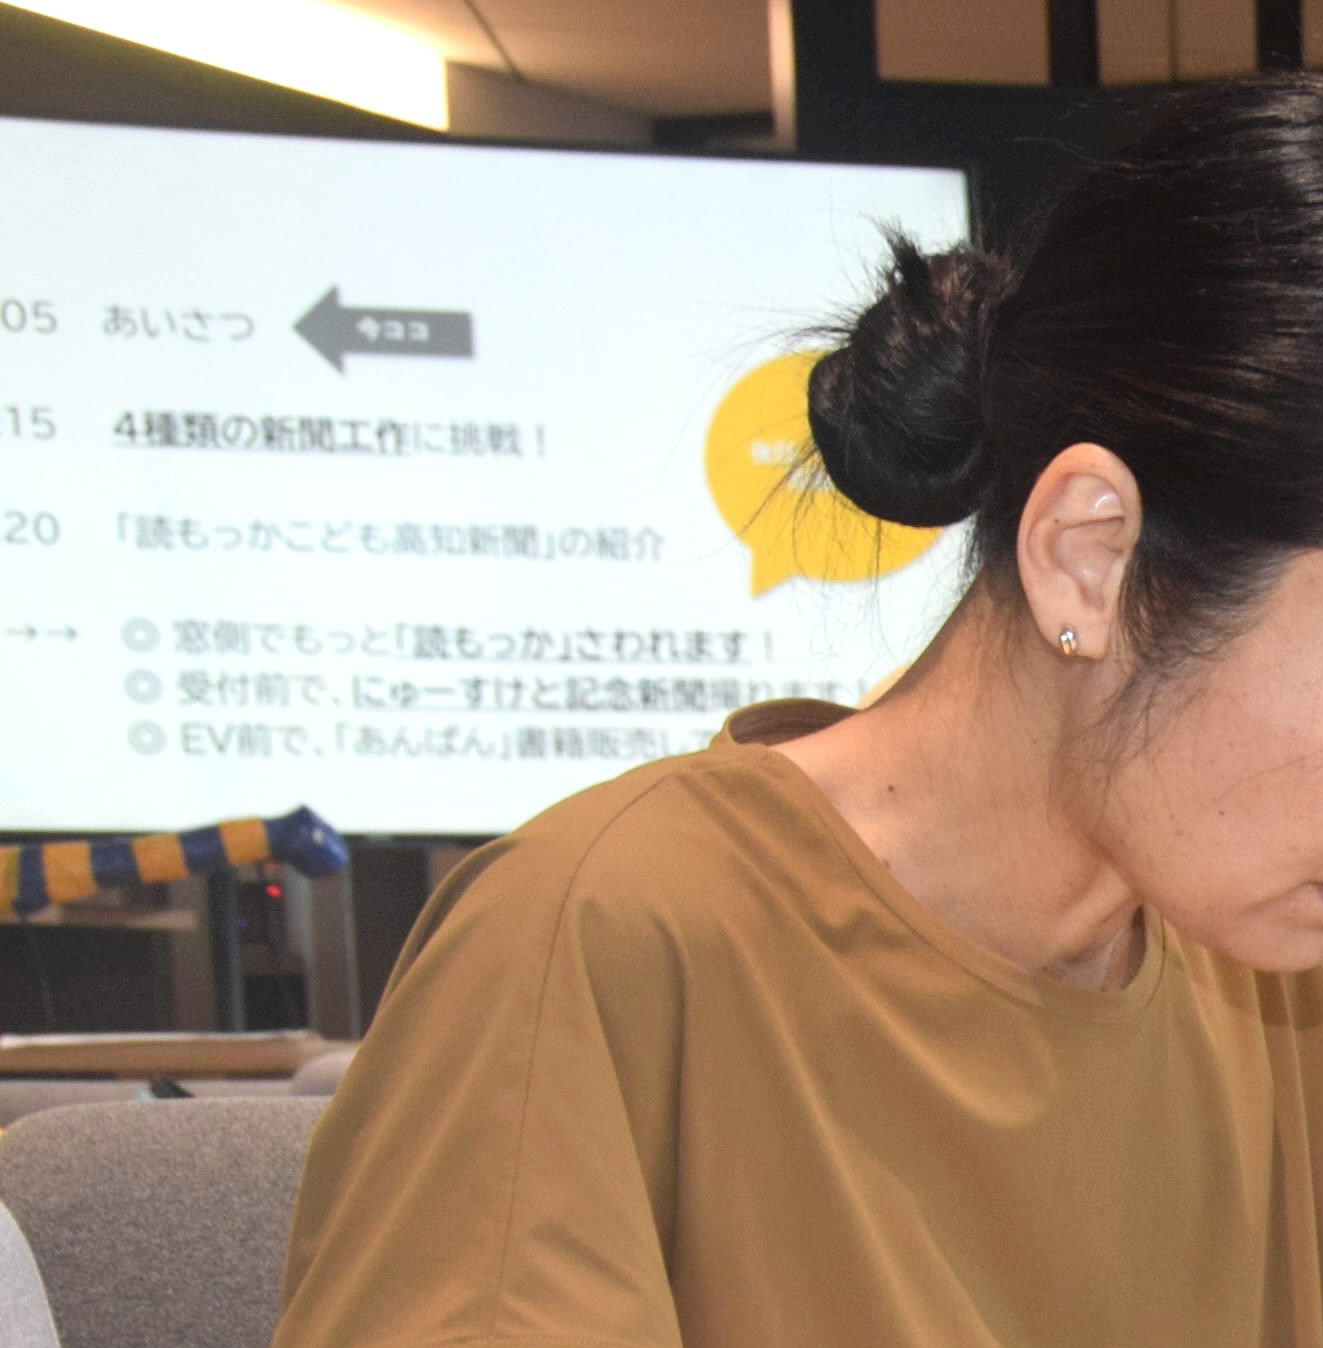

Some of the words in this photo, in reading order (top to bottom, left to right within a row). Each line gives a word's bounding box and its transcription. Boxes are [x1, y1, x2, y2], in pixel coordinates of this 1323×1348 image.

[0, 299, 59, 334] 05
[102, 304, 256, 342] あいさつ
[355, 316, 430, 343] 今ココ
[3, 510, 60, 545] 20
